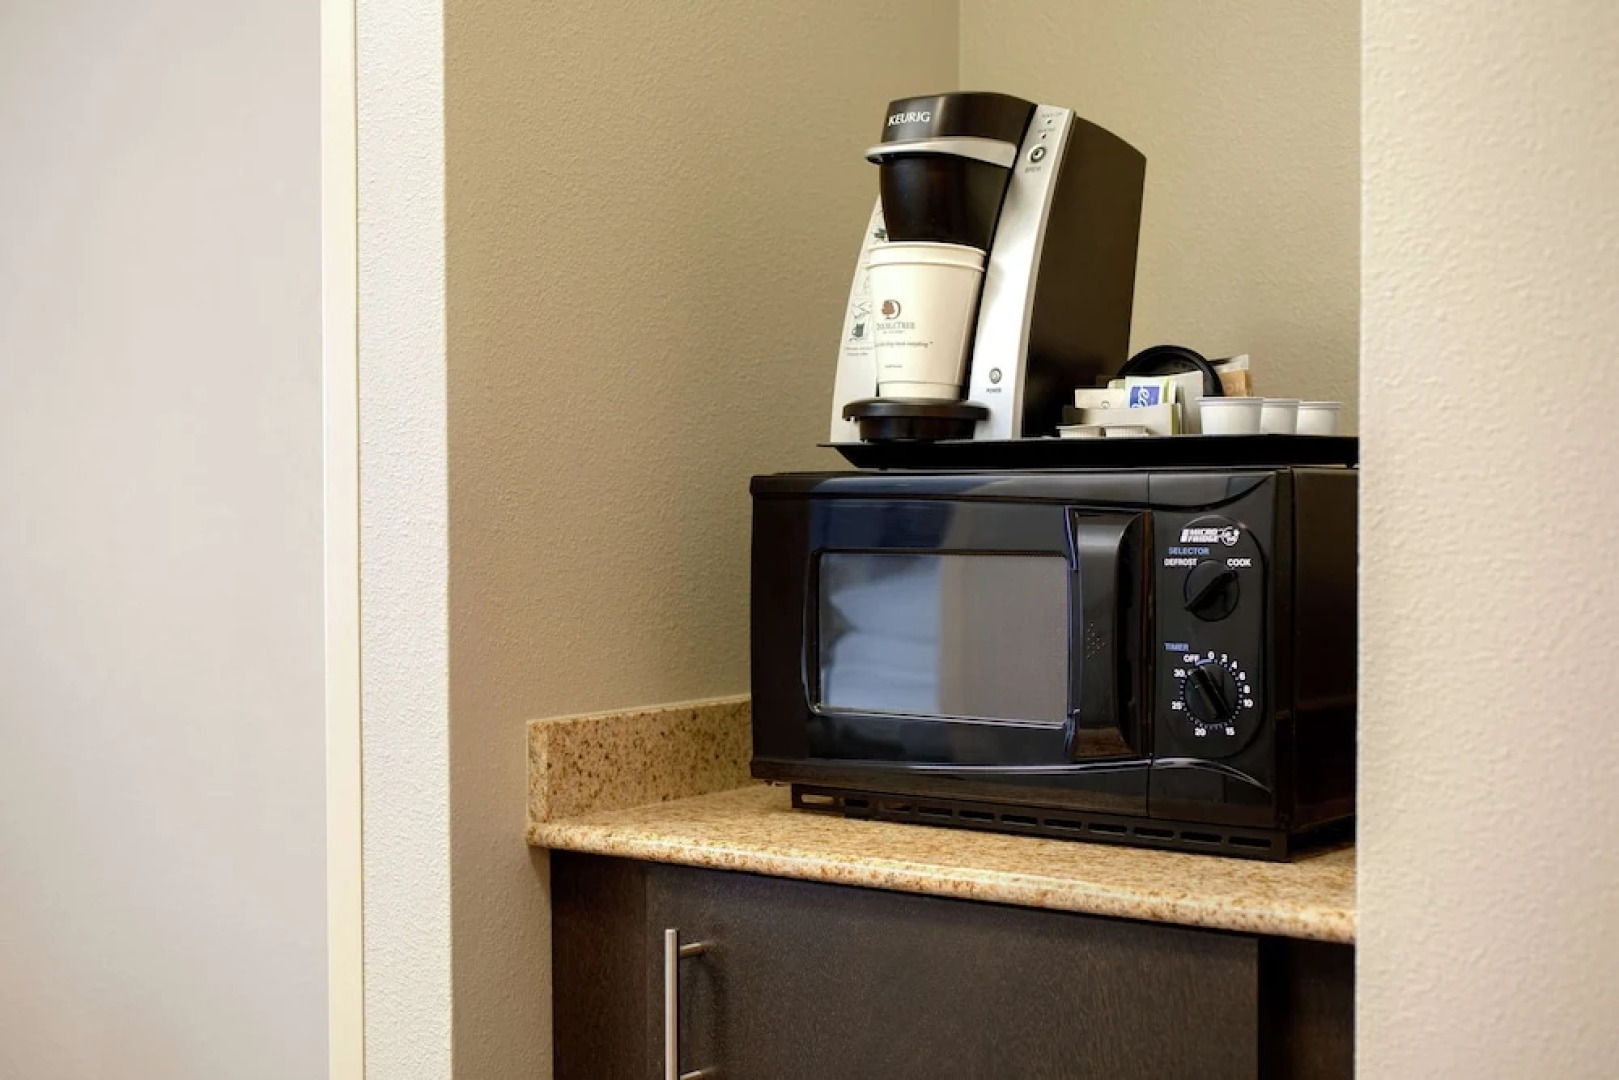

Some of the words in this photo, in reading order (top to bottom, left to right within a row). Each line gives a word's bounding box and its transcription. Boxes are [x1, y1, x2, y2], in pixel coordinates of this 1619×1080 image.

[888, 111, 931, 127] KEURIG
[1168, 546, 1210, 555] SELECTOR
[1163, 558, 1198, 567] DEFROST
[1226, 558, 1252, 567] COOK
[1165, 642, 1189, 651] TIMER
[1183, 653, 1200, 662] OFF
[1207, 650, 1215, 660] 0
[1231, 660, 1238, 670] 4
[1173, 668, 1185, 678] 30
[1171, 700, 1182, 710] 25
[1243, 698, 1253, 708] 10
[1194, 726, 1207, 737] 20
[1225, 726, 1235, 736] 15
